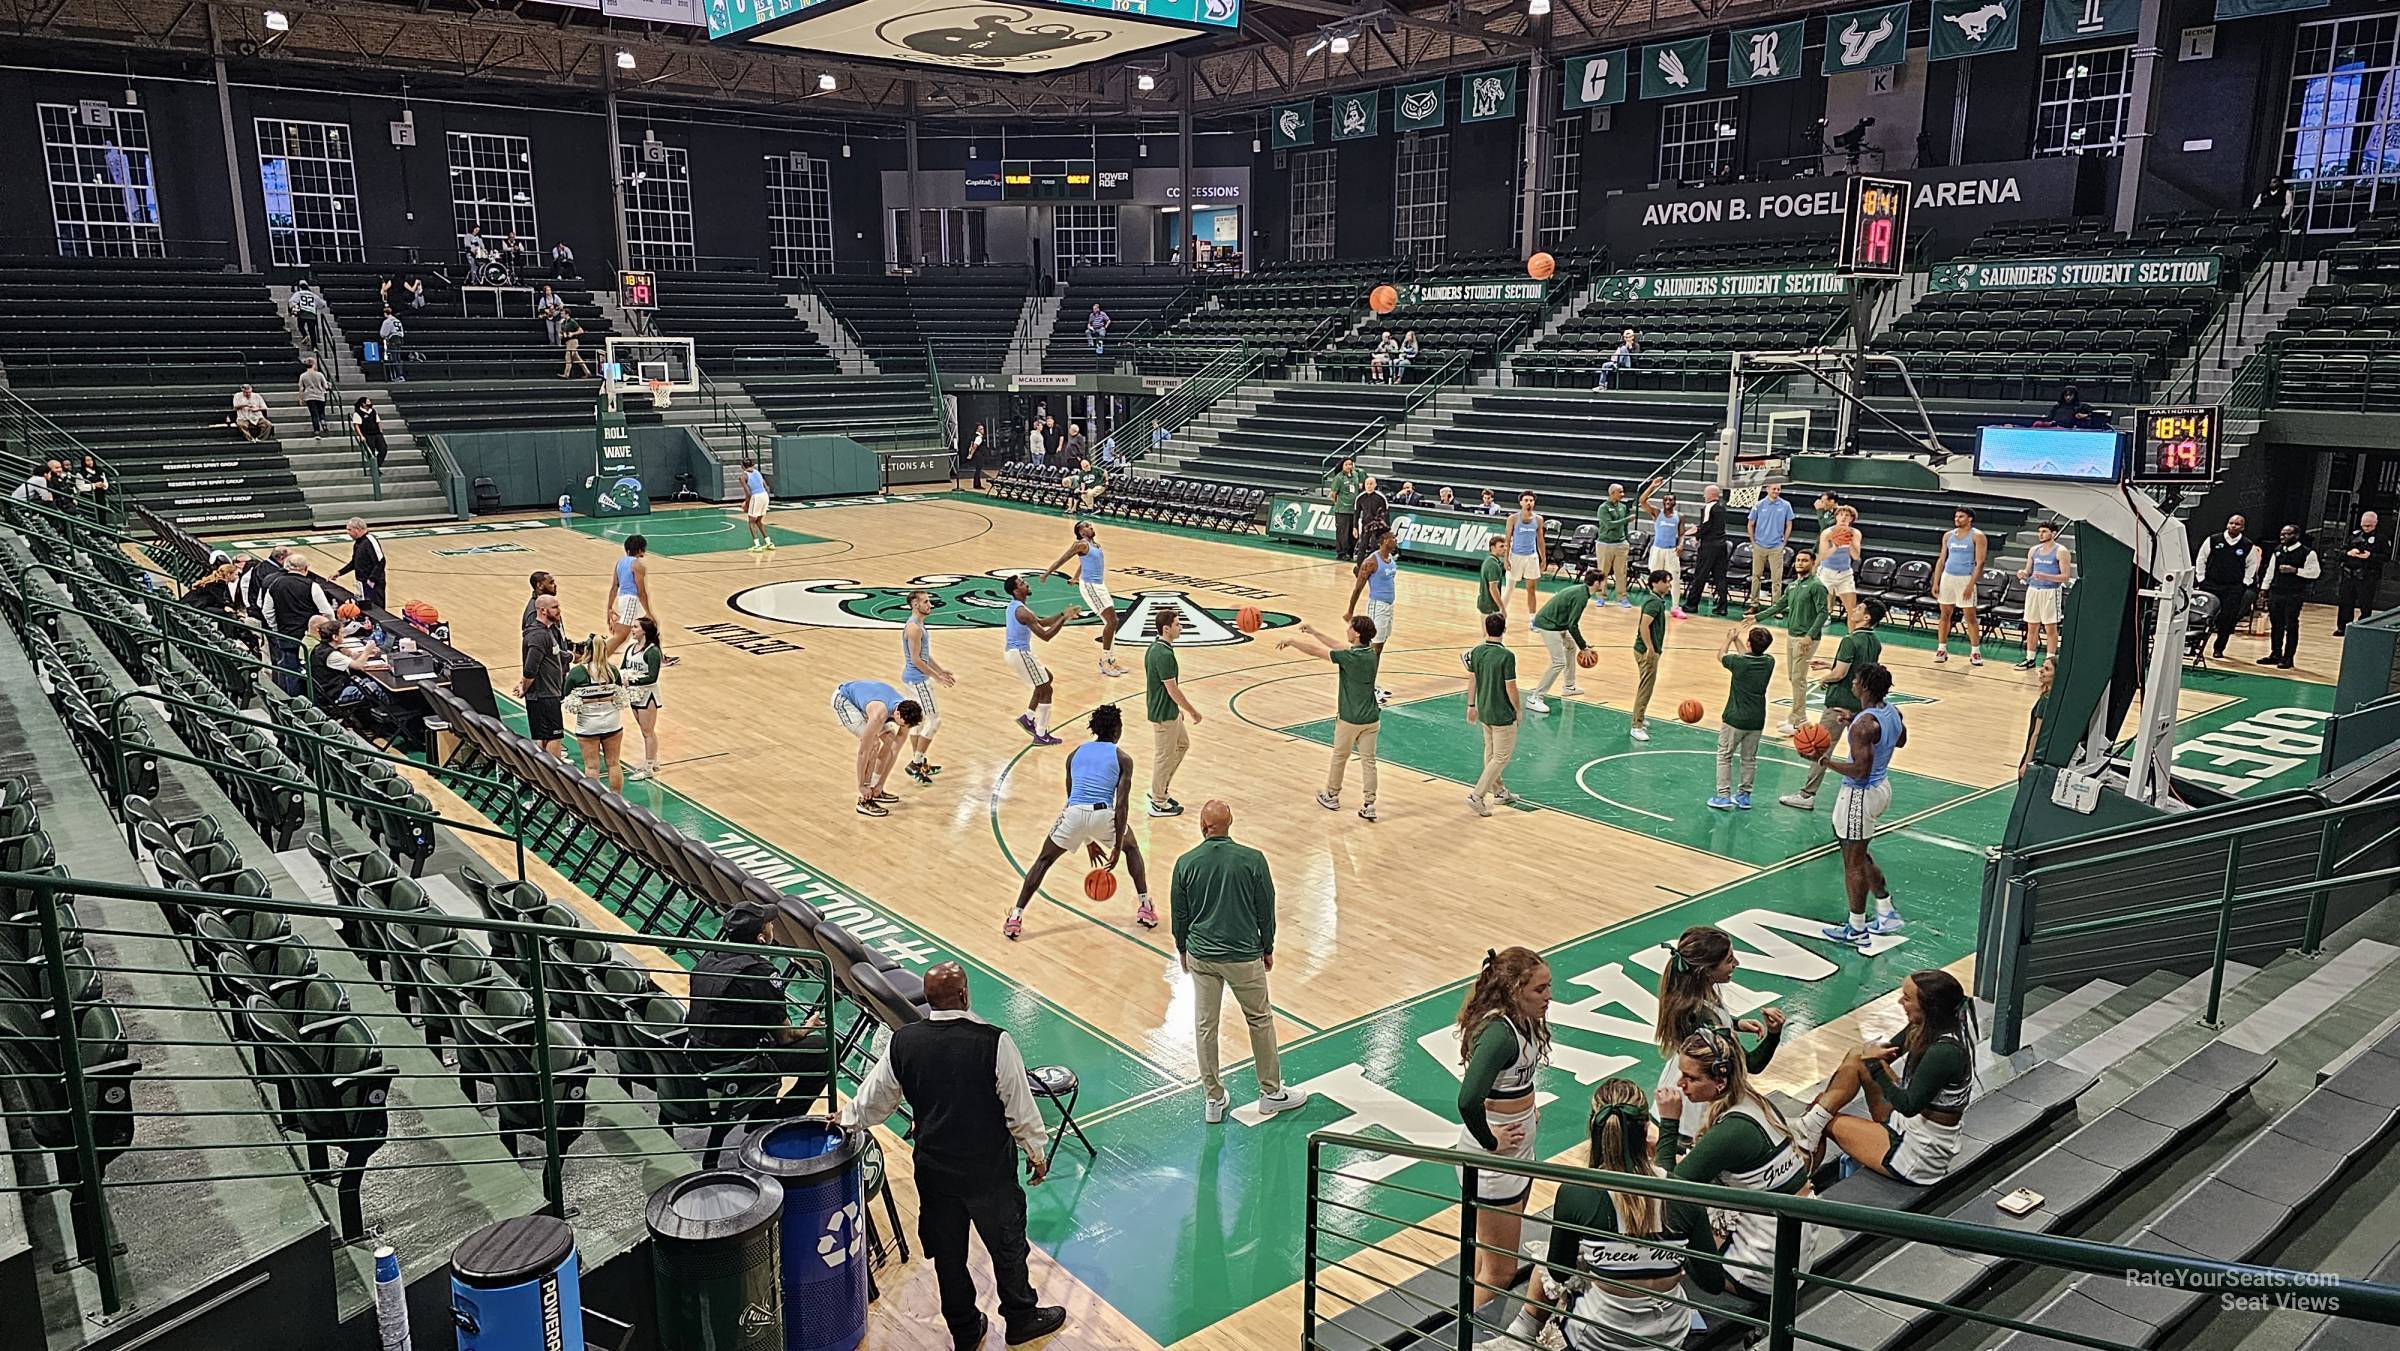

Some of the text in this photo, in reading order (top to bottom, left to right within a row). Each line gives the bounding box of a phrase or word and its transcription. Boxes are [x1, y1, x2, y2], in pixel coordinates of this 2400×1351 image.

[2184, 27, 2214, 36] SECTION
[2190, 38, 2203, 56] L
[1874, 75, 1888, 91] K
[91, 109, 102, 123] E
[1597, 114, 1604, 128] J
[399, 130, 408, 142] F
[649, 147, 660, 160] G
[794, 158, 805, 170] H
[1099, 173, 1129, 181] POWER
[1166, 186, 1240, 198] COCESSIONS
[1642, 199, 1722, 227] AVRON
[1729, 198, 1751, 221] B.
[1914, 178, 2021, 208] ARENA
[1866, 219, 1892, 264] 19
[1979, 262, 2211, 286] SAUNDERS STUDENT SECTION
[1421, 283, 1541, 300] SAUNDERS STUDENT SECTION
[1653, 273, 1843, 297] SAUNDERS STUDENT SECTION
[300, 295, 315, 307] 92
[633, 286, 649, 304] 19
[1056, 376, 1069, 384] WAY
[603, 426, 628, 440] ROLL
[2155, 416, 2208, 439] 18:41
[603, 445, 632, 458] WAVE
[2166, 441, 2197, 468] 19
[919, 460, 935, 469] A-E
[1391, 516, 1459, 549] GREEN
[683, 622, 806, 655] DEVLIN
[1763, 1160, 1794, 1184] Green
[1592, 1246, 1640, 1266] Green
